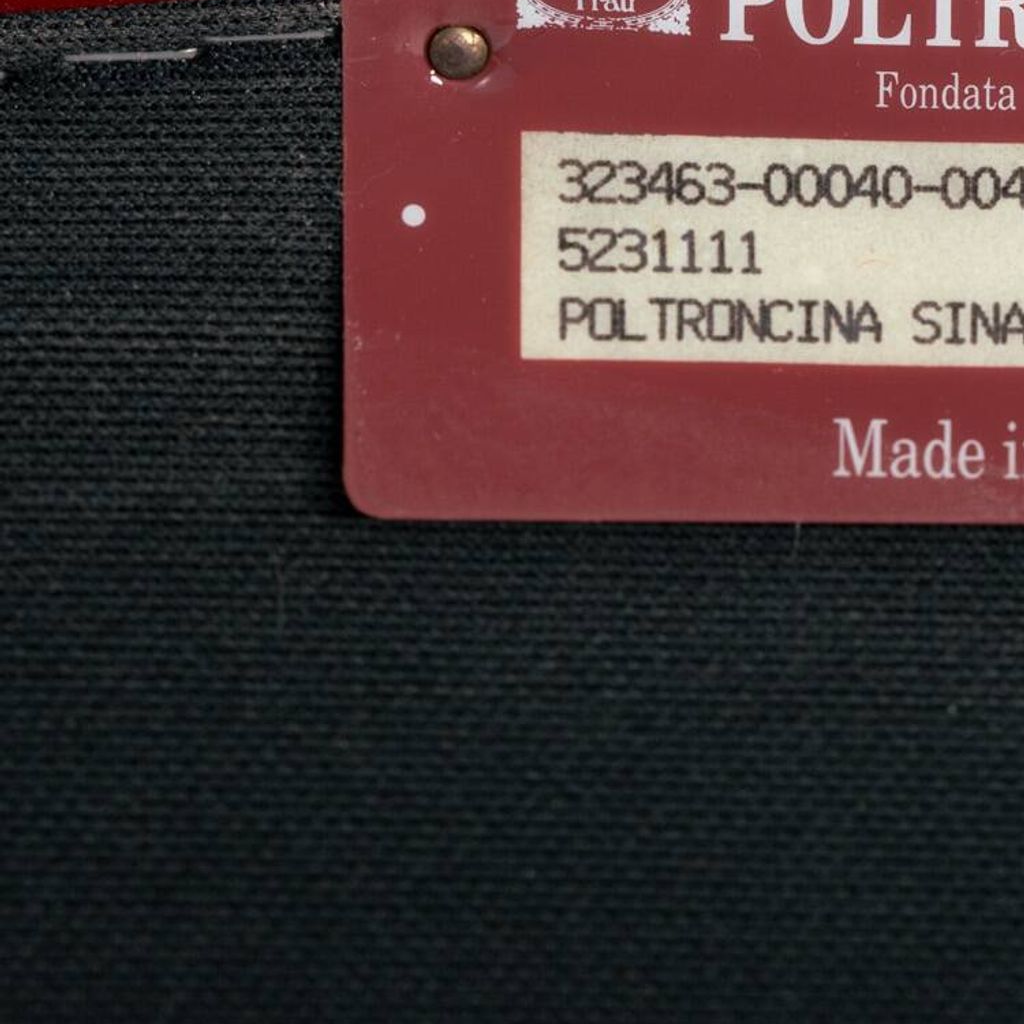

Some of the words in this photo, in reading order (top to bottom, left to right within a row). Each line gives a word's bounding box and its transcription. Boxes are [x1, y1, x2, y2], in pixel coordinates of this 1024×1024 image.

[875, 71, 1016, 111] Fondata
[557, 228, 763, 275] 5231111
[558, 297, 882, 343] POLTRONCINA
[833, 418, 986, 479] Made
